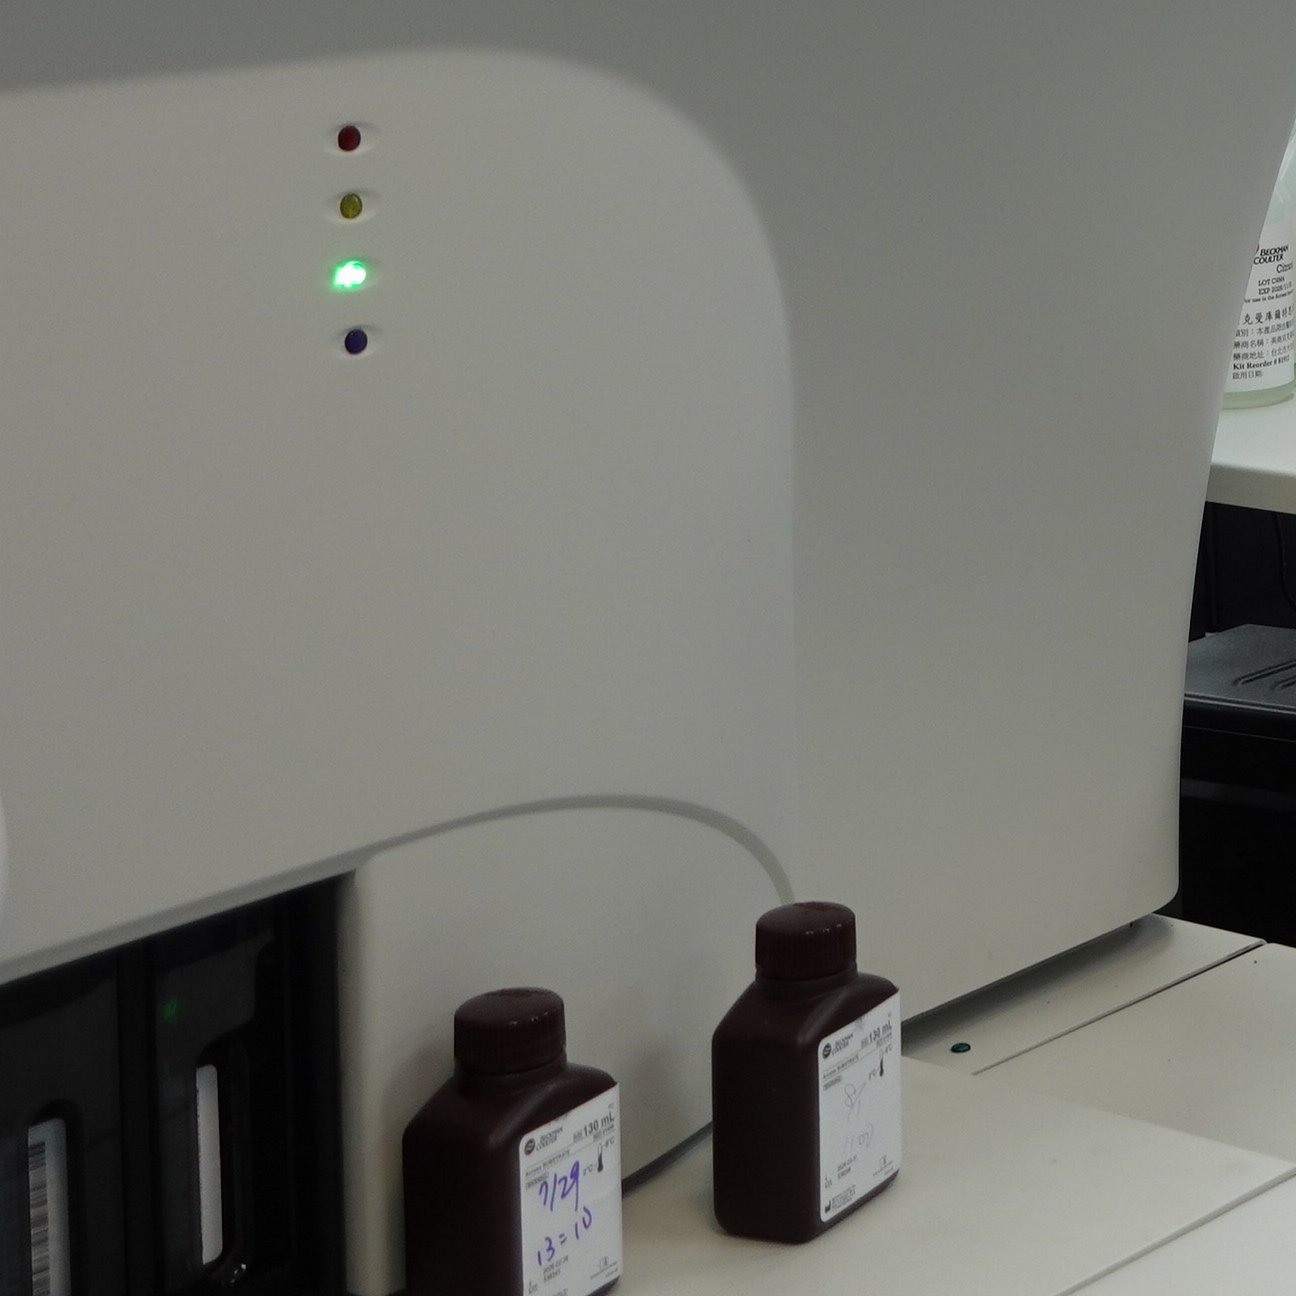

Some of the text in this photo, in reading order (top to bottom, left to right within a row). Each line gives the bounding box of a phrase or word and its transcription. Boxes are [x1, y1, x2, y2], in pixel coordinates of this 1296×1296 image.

[1258, 278, 1271, 287] LOT
[1246, 360, 1273, 369] Reorder
[583, 1111, 615, 1137] 130 mL
[539, 1160, 580, 1212] 7/29
